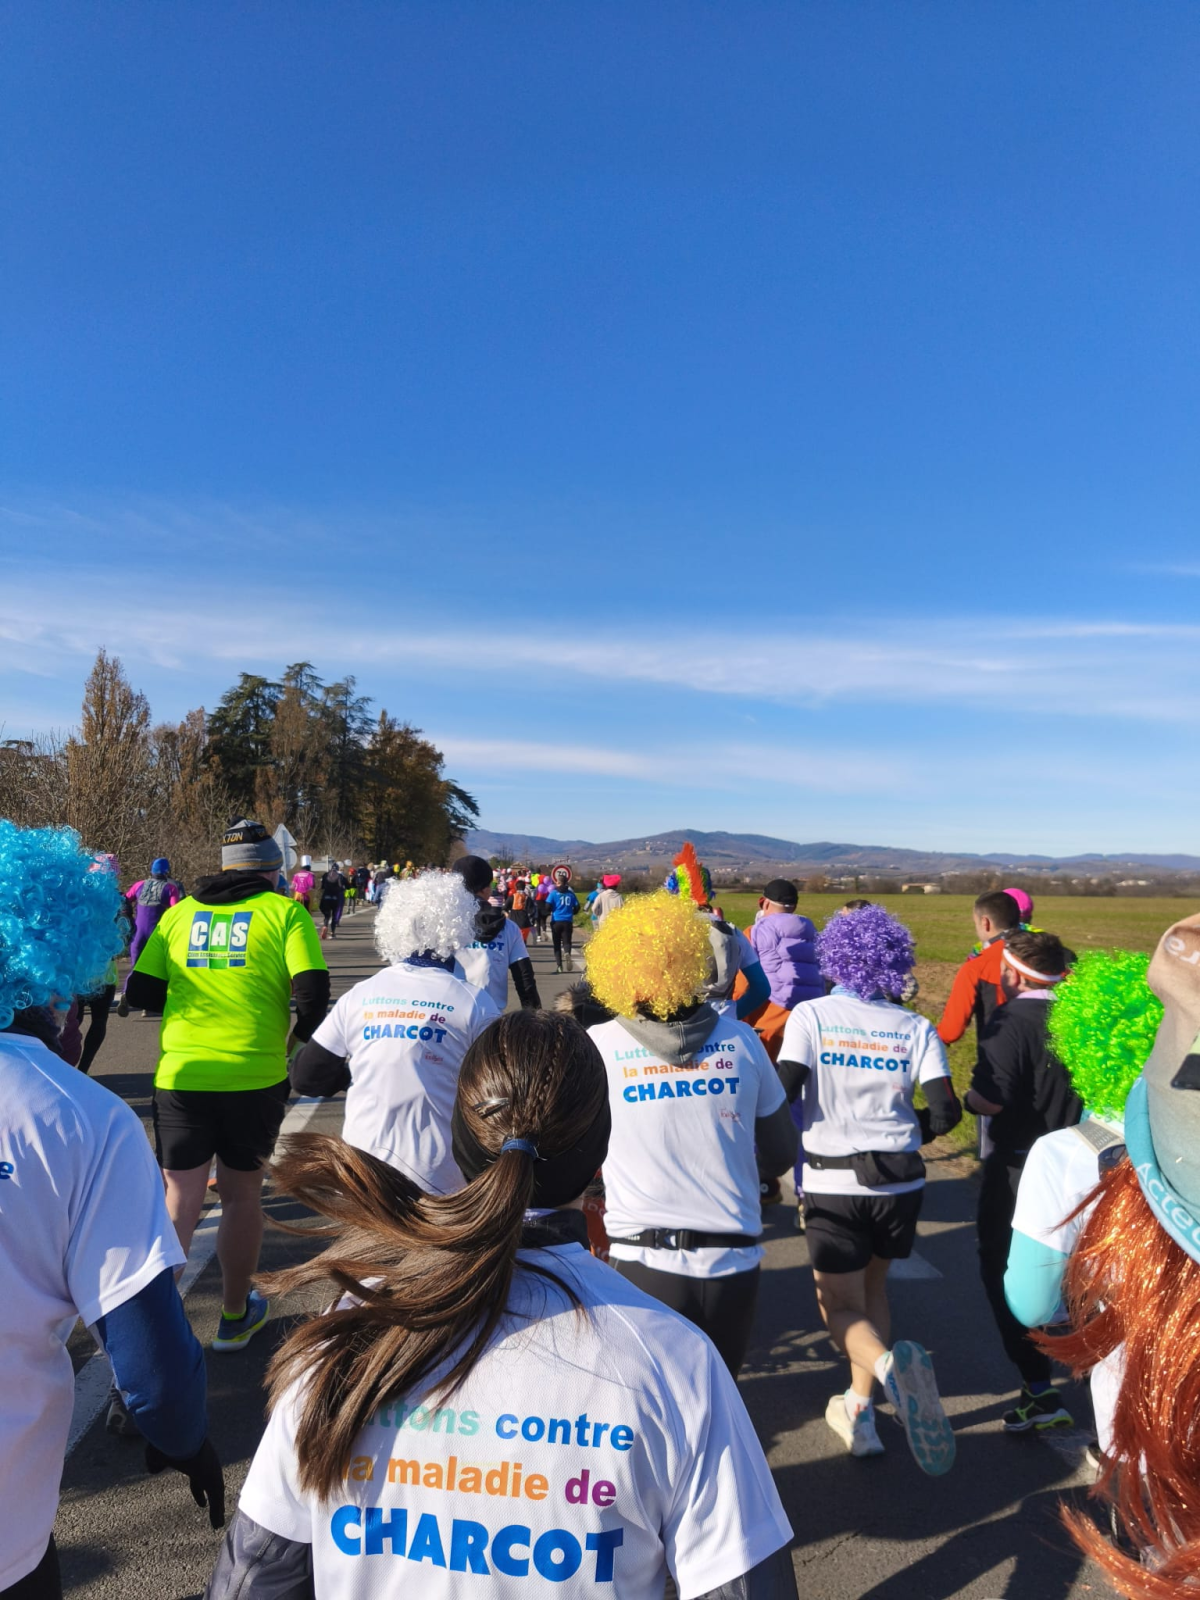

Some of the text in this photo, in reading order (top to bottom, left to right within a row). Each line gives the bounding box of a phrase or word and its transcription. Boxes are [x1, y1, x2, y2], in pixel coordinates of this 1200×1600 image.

[560, 895, 572, 906] 10
[190, 920, 249, 947] CAS
[463, 940, 505, 952] ARCOT
[362, 996, 455, 1012] Luttons contre
[363, 1009, 447, 1024] la maladie de
[363, 1023, 448, 1044] CHARCOT
[820, 1024, 911, 1040] Luttons contre
[614, 1041, 736, 1061] Lutt ontre
[822, 1037, 908, 1054] la maladie de
[623, 1066, 638, 1078] la
[715, 1058, 734, 1070] de
[820, 1051, 911, 1073] CHARCOT
[622, 1076, 740, 1103] CHARCOT
[368, 1396, 635, 1452] ttons contre
[388, 1455, 550, 1501] maladie
[564, 1468, 617, 1507] de
[330, 1504, 624, 1583] CHARCOT
